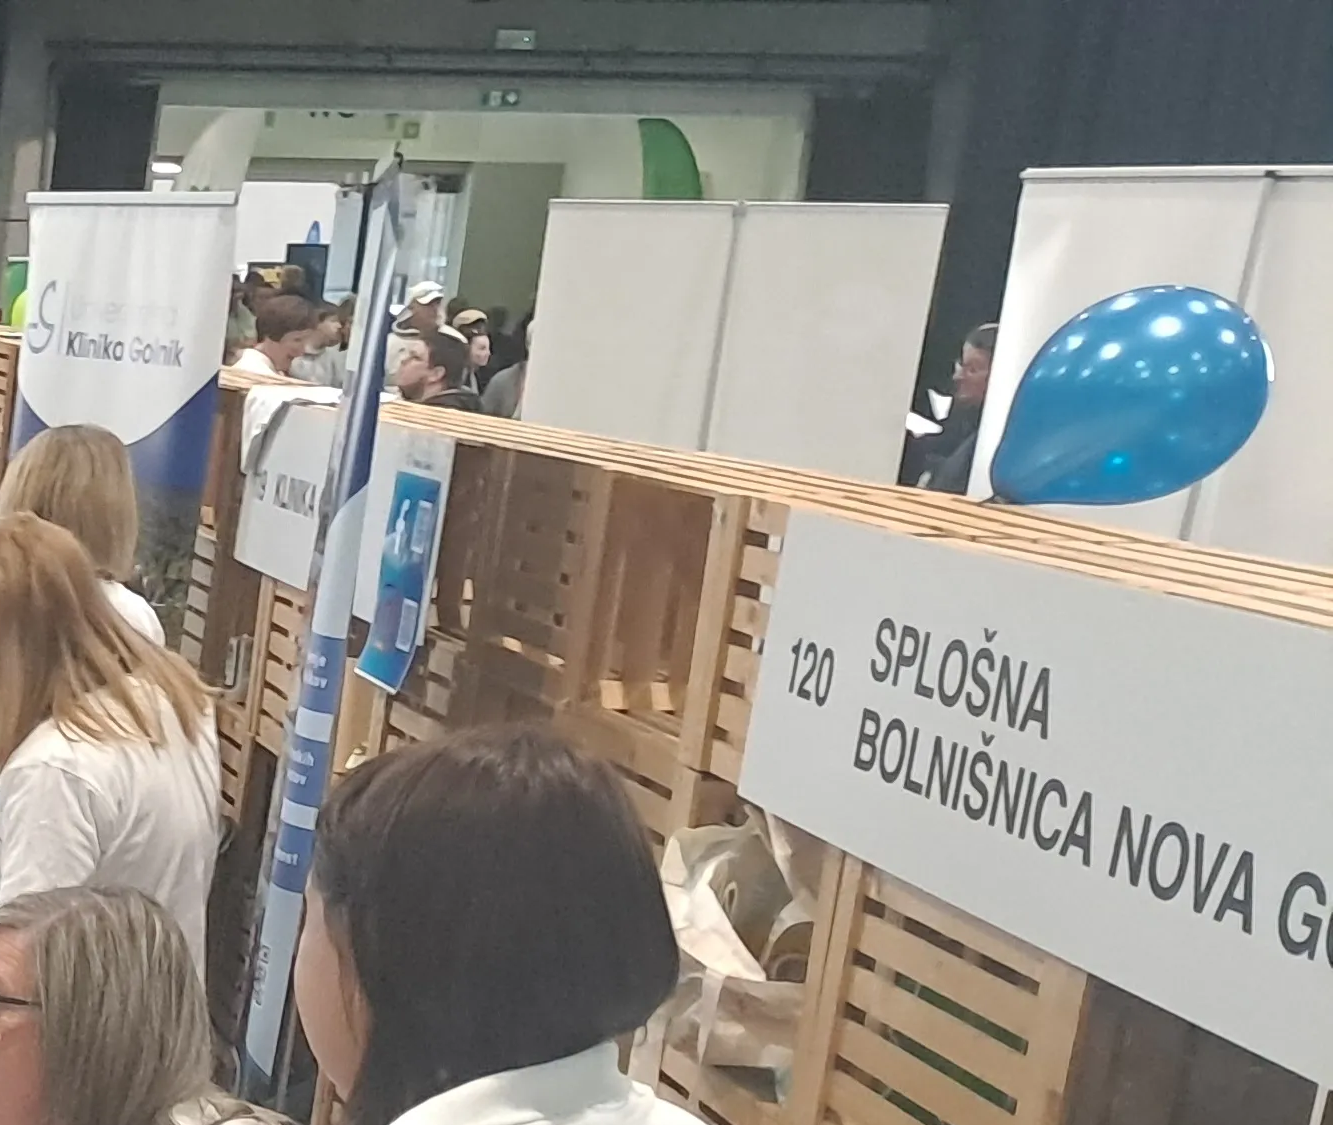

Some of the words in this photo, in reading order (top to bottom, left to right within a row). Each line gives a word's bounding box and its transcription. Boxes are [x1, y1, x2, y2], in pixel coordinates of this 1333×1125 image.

[65, 330, 124, 362] Klinika
[788, 637, 834, 707] 120
[870, 617, 1051, 740] SPLOŠNA
[853, 707, 1092, 868] BOLNIŠNICA
[1108, 805, 1255, 935] NOVA
[1277, 870, 1333, 970] G
